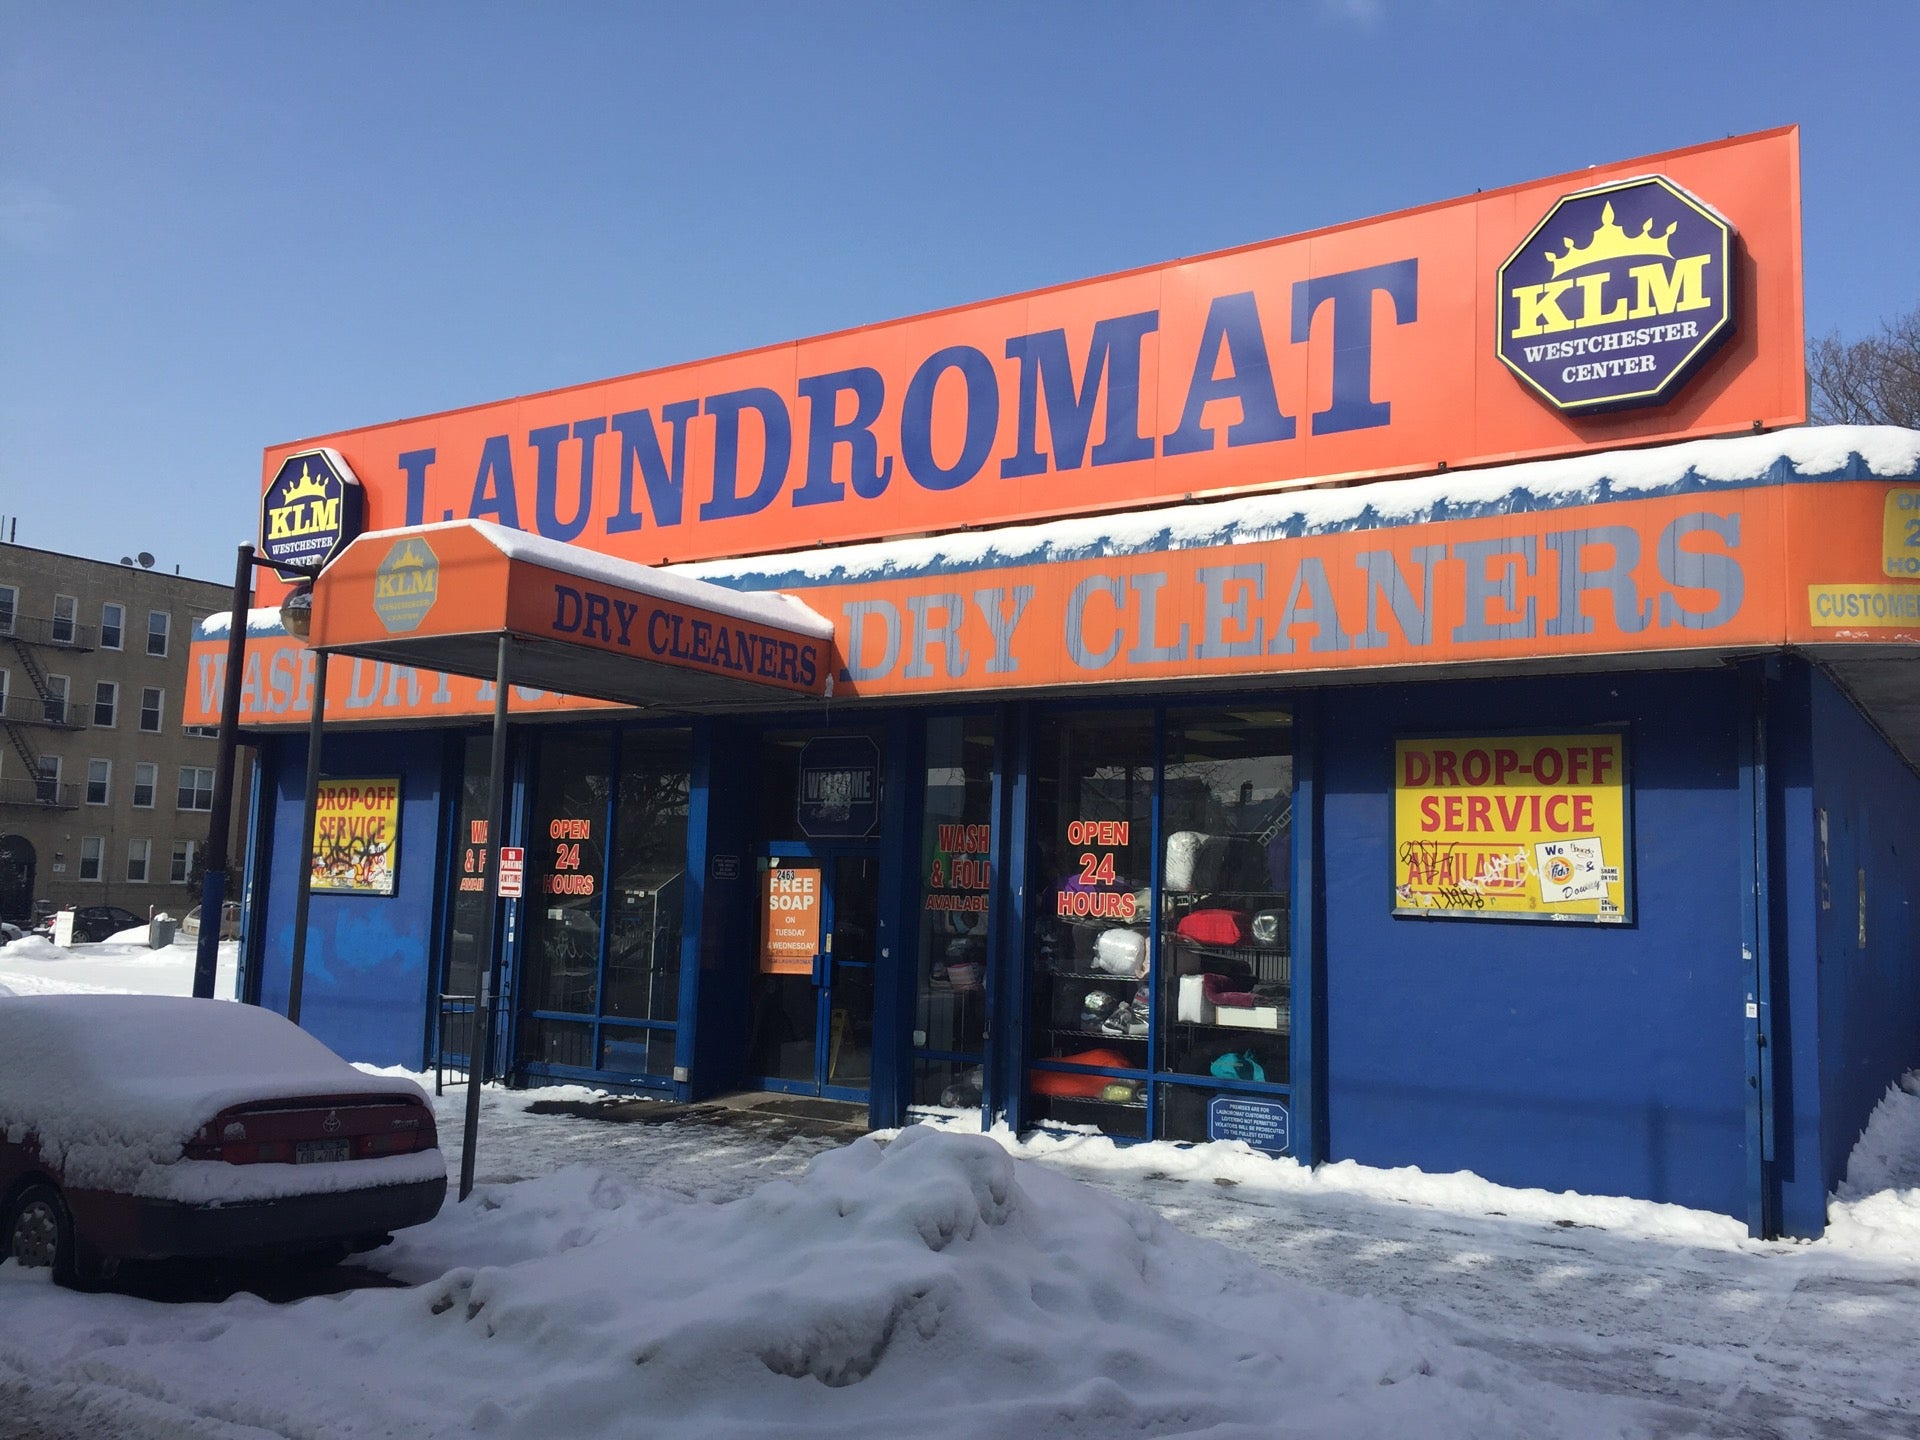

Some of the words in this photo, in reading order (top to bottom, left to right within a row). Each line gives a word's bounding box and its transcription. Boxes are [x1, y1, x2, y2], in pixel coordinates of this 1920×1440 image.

[1512, 254, 1711, 339] KLM
[1524, 321, 1698, 363] WESTCHESTER
[1562, 355, 1656, 383] CENTER
[399, 258, 1418, 542] LAUNDROMAT
[268, 498, 339, 540] KLM
[272, 537, 333, 555] WESTCHESTER
[377, 568, 434, 598] KLM
[837, 583, 1035, 682] DRY
[1065, 512, 1745, 669] CLEANERS
[552, 584, 638, 646] DRY
[648, 609, 817, 686] CLEANERS
[1403, 746, 1614, 787] DROP-OFF
[316, 786, 395, 811] DROP-OFF
[1420, 795, 1594, 832] SERVICE
[319, 816, 385, 839] SERVICE
[550, 819, 590, 839] OPEN
[938, 824, 990, 853] WASH
[1067, 820, 1129, 846] OPEN
[555, 844, 580, 869] 24
[1545, 845, 1564, 855] We
[501, 860, 522, 869] PARKING
[777, 870, 794, 880] 2463
[930, 859, 944, 888] &
[1079, 852, 1116, 886] 24
[543, 875, 594, 895] HOURS
[770, 878, 813, 892] FREE
[769, 895, 814, 910] SOAP
[925, 894, 989, 913] AVAILABL
[1057, 890, 1136, 918] HOURS
[1214, 1121, 1237, 1129] VIOLATORS
[1216, 1109, 1244, 1117] LAUNDROMAT
